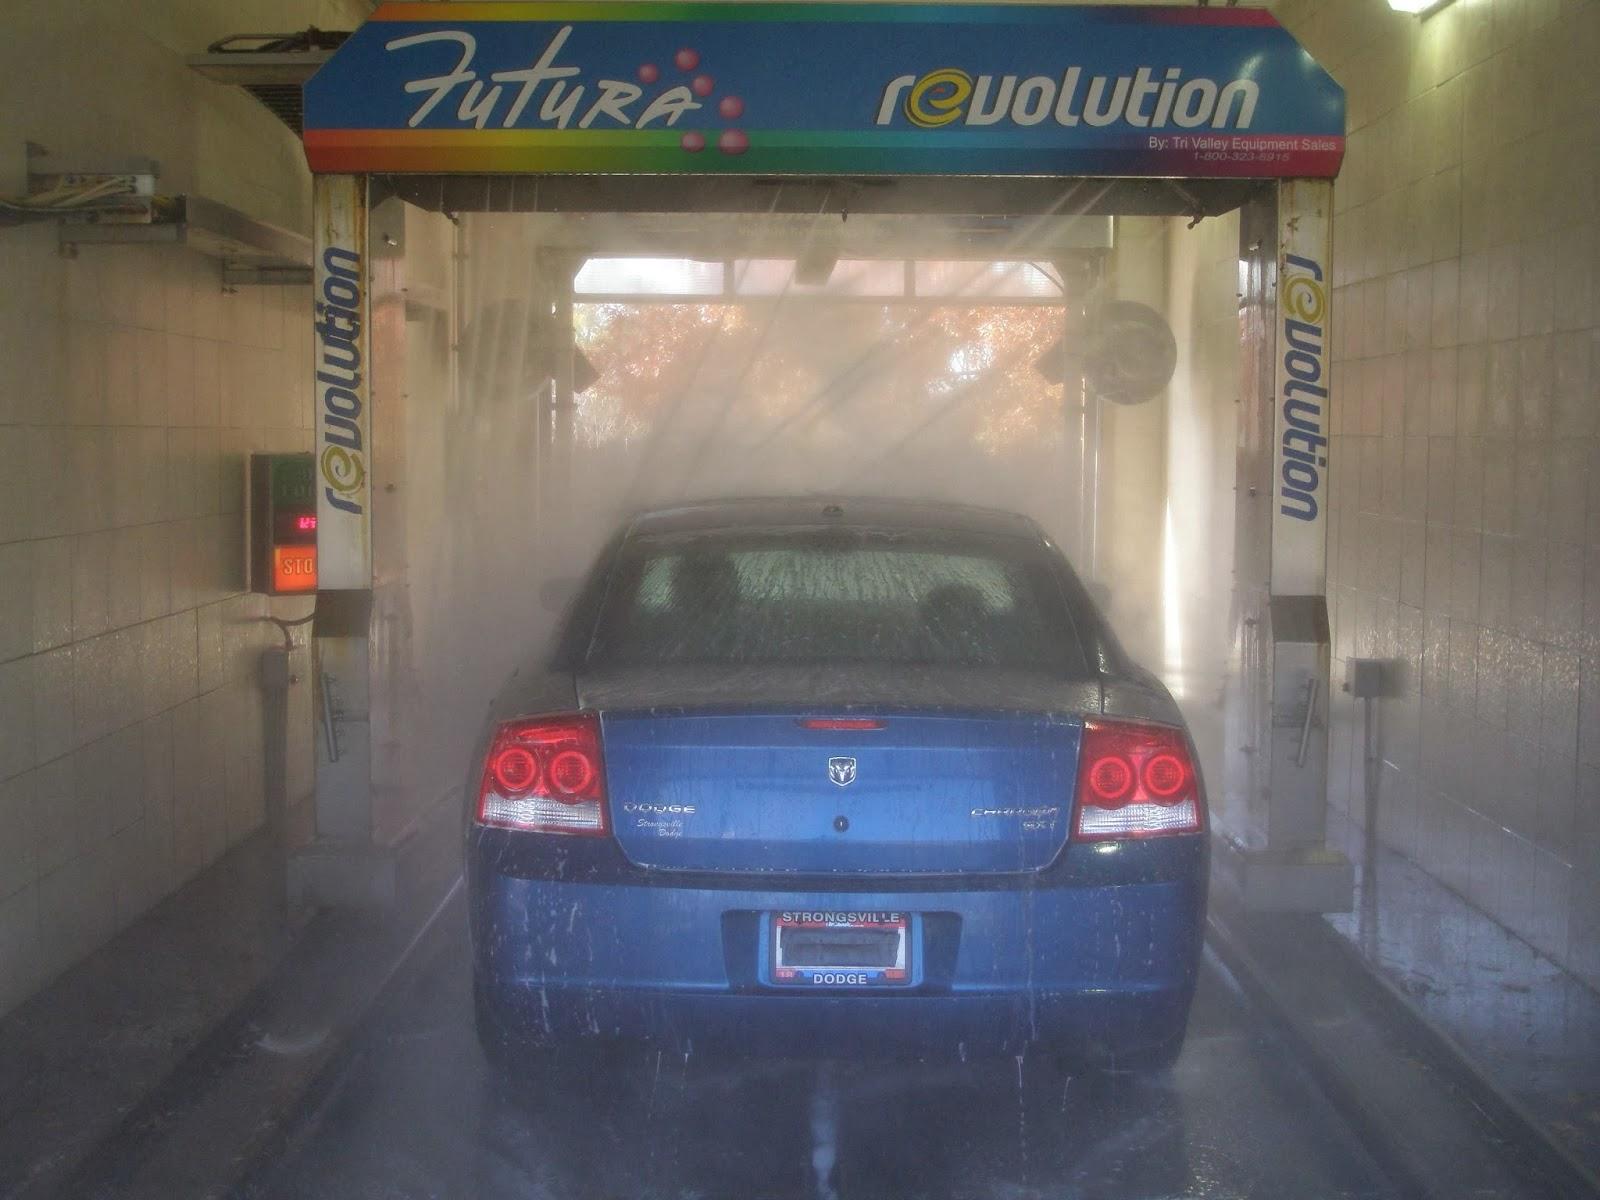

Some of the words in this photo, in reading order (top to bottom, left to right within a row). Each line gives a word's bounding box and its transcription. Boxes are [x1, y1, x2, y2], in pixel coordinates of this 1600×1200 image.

[876, 66, 1261, 129] revolution
[1148, 136, 1169, 151] By:
[1173, 136, 1188, 149] Tri
[1192, 137, 1228, 151] Valley
[1232, 138, 1298, 152] Equipment
[1302, 138, 1337, 151] Sales
[316, 246, 366, 515] revolution
[1280, 253, 1328, 522] revolution
[782, 911, 900, 923] STRONGSVILLE
[813, 973, 867, 985] DODGE
